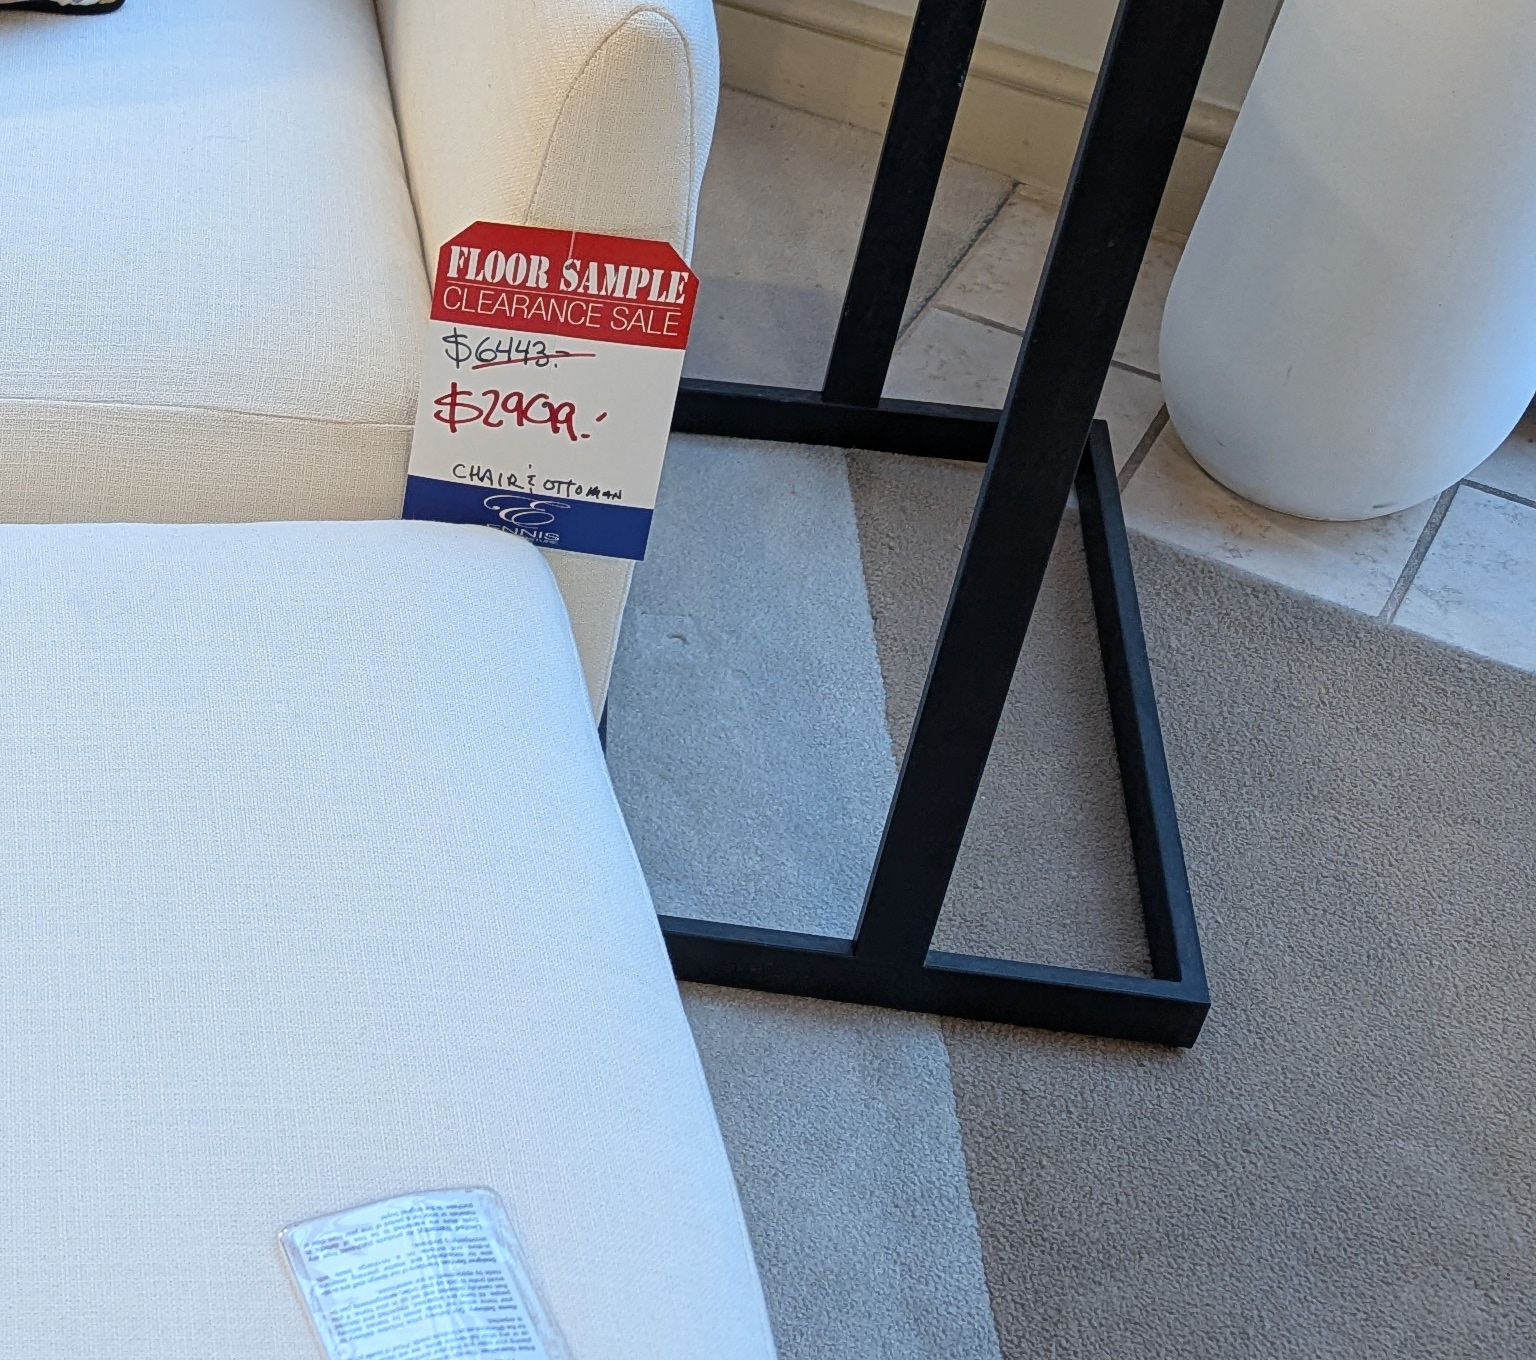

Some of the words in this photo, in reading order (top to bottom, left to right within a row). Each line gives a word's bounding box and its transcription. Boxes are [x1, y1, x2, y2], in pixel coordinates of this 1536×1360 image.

[447, 245, 550, 289] FLOOR
[560, 258, 690, 305] SAMPLE
[443, 285, 604, 328] CLEARANCE
[610, 306, 682, 336] SALE
[452, 463, 525, 490] CHAIR
[542, 478, 623, 501] OTTOMAN
